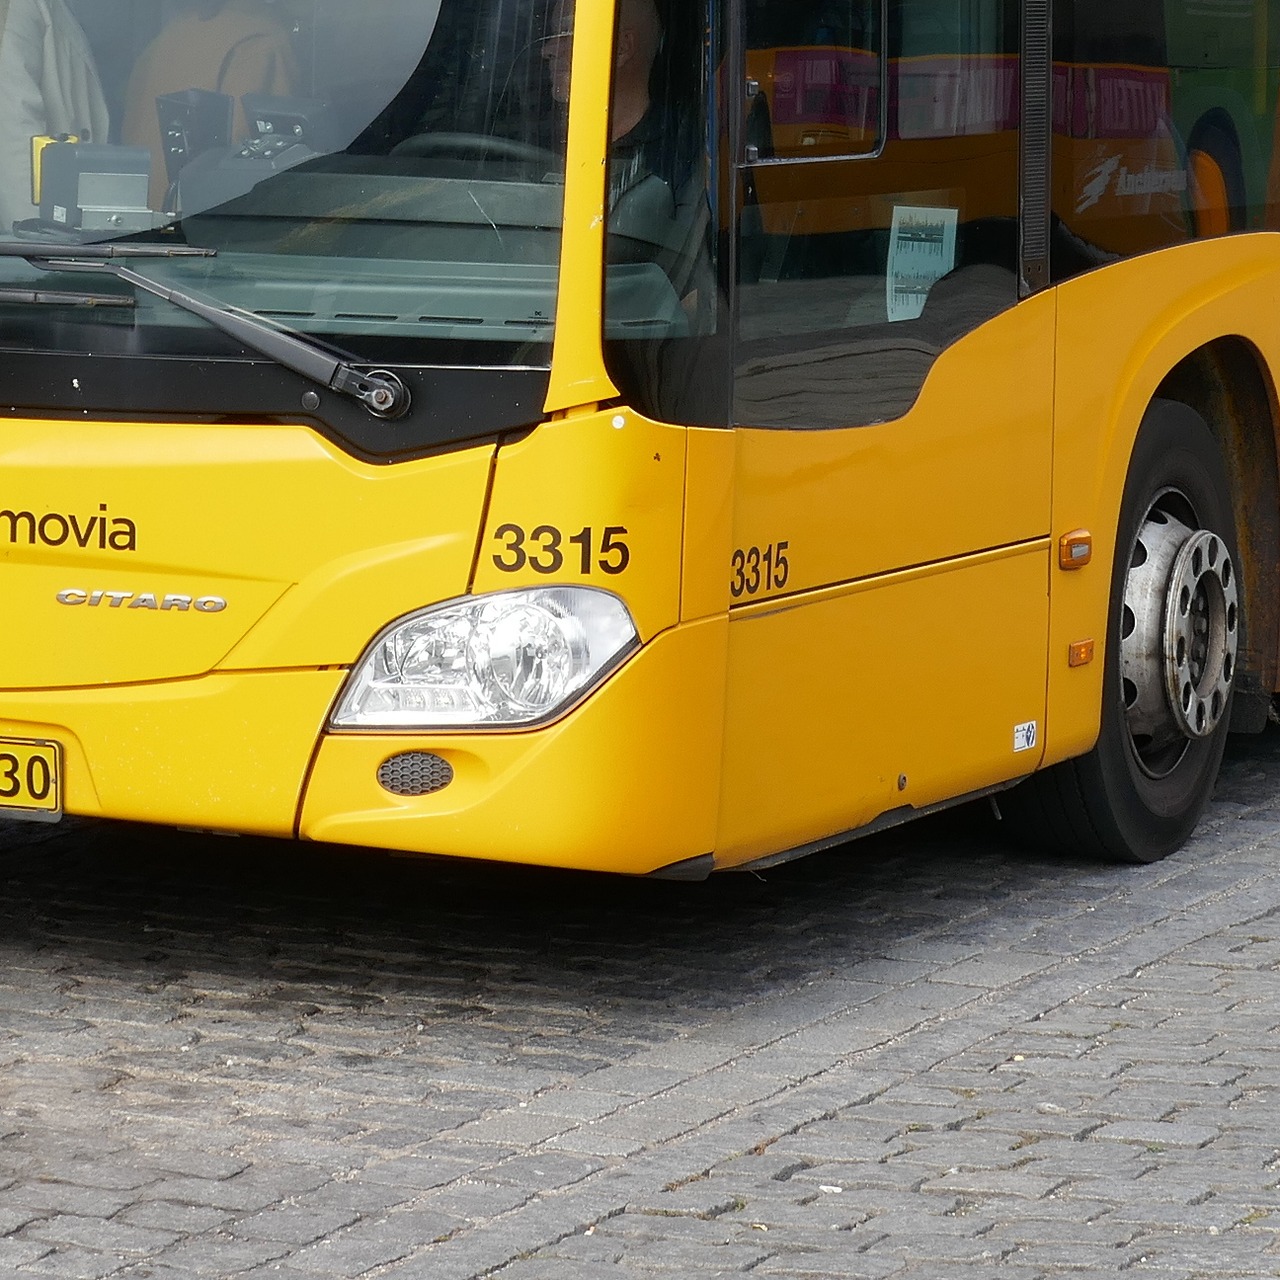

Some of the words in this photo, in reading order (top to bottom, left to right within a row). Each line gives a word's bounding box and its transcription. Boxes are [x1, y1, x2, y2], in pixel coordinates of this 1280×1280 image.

[492, 523, 630, 574] 3315
[730, 541, 789, 598] 3315
[56, 588, 227, 613] CITARO
